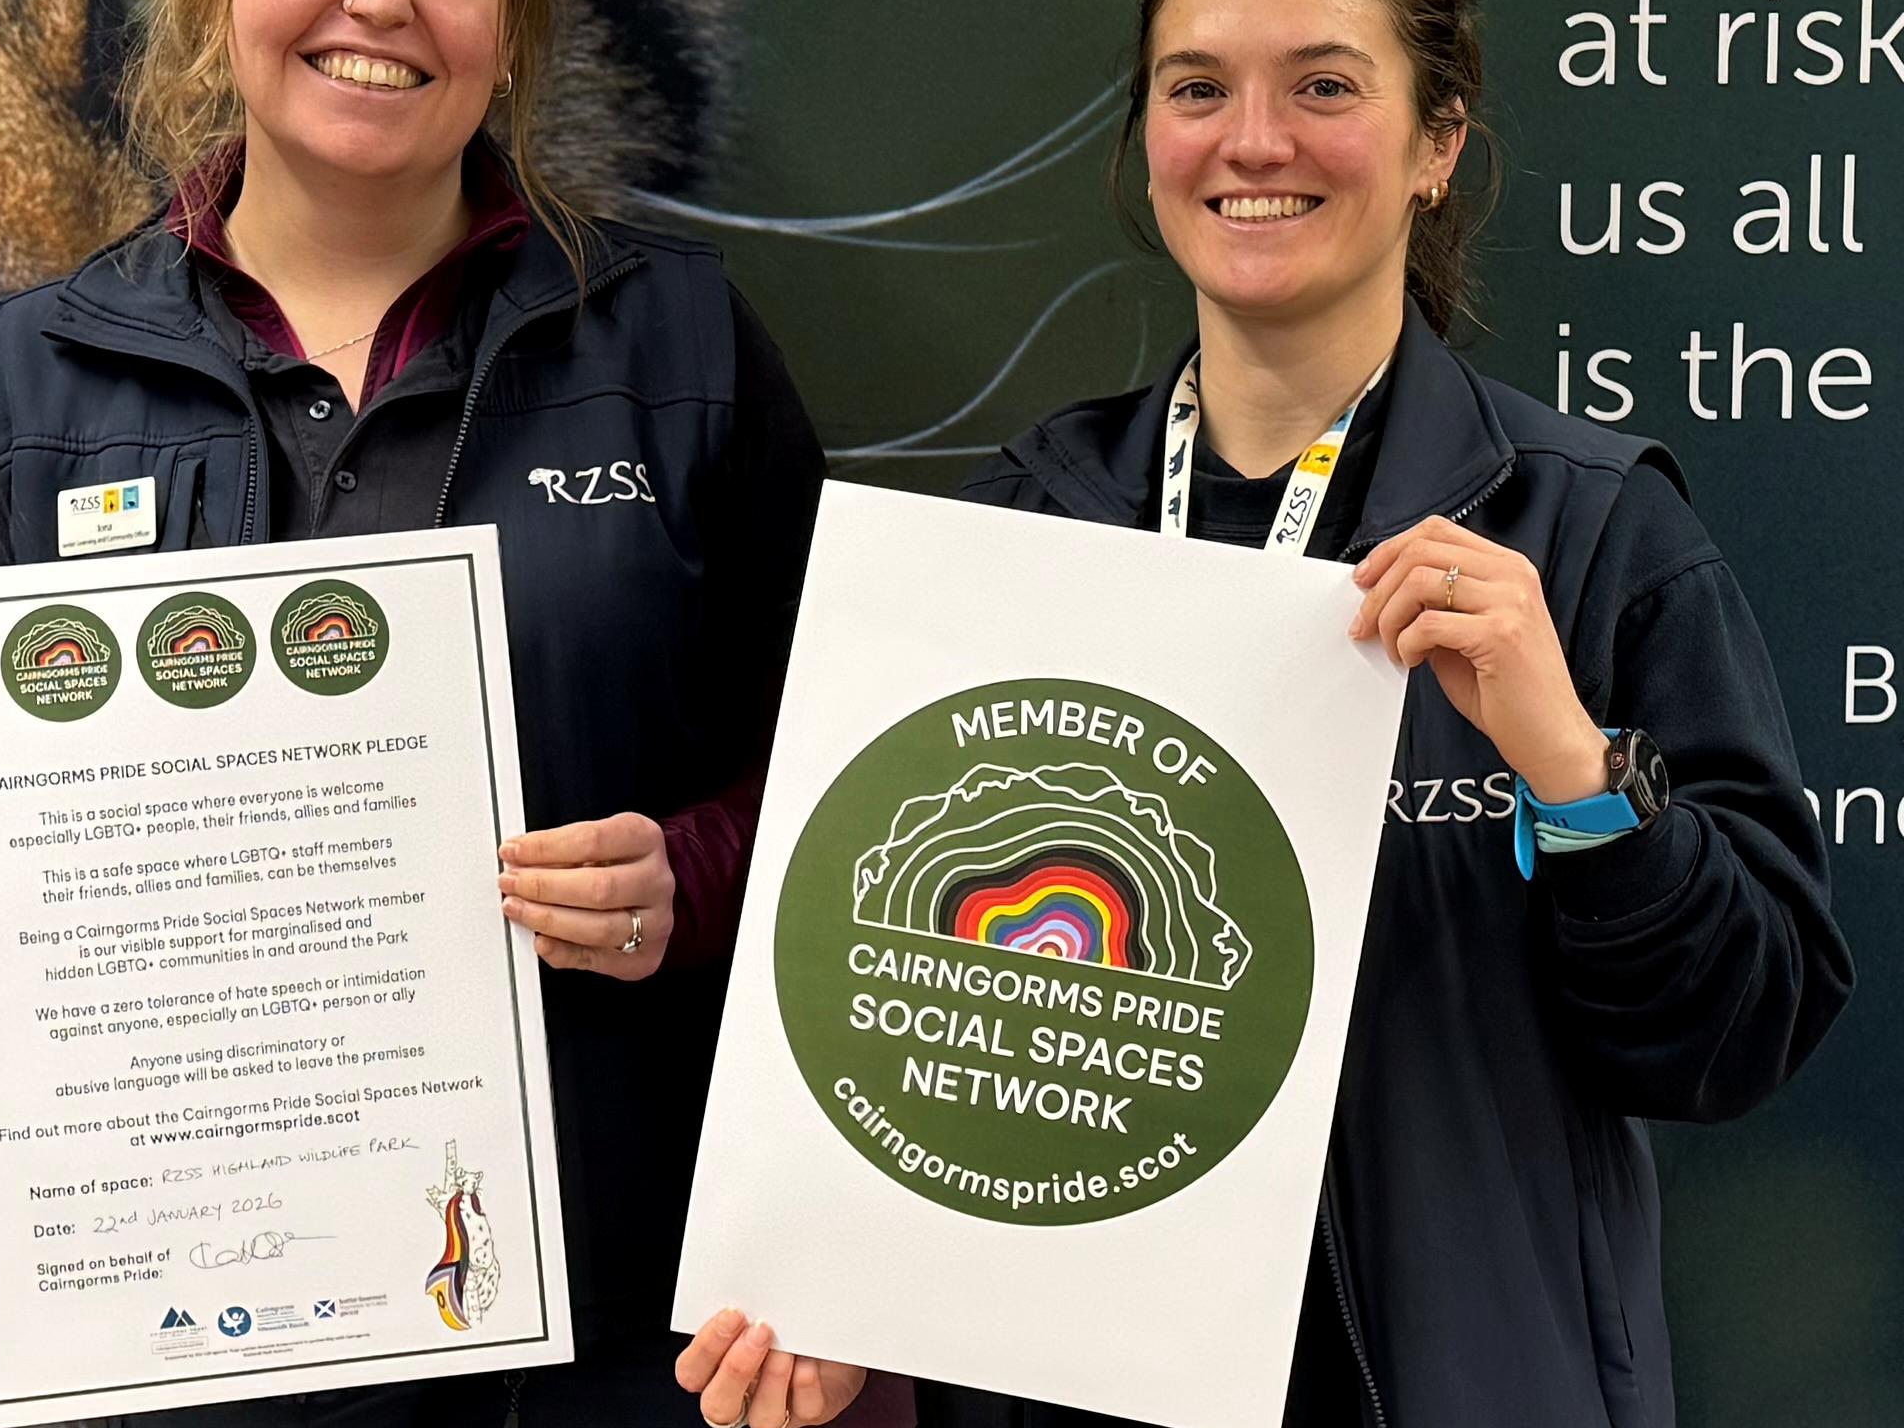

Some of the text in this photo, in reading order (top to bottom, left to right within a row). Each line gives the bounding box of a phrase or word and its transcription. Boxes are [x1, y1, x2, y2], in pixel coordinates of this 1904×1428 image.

[1561, 182, 1685, 254] us
[1733, 155, 1862, 253] all
[1559, 324, 1633, 421] is
[1681, 323, 1871, 419] the
[528, 461, 655, 504] RZSS
[1276, 486, 1313, 544] RZSS
[289, 650, 376, 668] SOCIAL SPACES
[306, 664, 362, 680] NETWORK
[99, 762, 147, 781] PRIDE
[150, 756, 212, 776] SOCIAL
[215, 749, 278, 770] SPACES
[281, 740, 363, 763] NETWORK
[366, 734, 429, 755] PLEDGE
[951, 699, 1218, 786] MEMBER OF
[37, 781, 385, 826] This is a social space where everyone is welcome
[848, 943, 1224, 1040] CAIRNGORMS PRIDE
[129, 1035, 346, 1072] Anyone using discriminatory or
[849, 993, 1204, 1091] SOCIAL SPACES
[35, 1124, 60, 1139] out
[63, 1121, 103, 1136] more
[106, 1113, 151, 1131] about
[154, 1110, 179, 1125] the
[182, 1101, 270, 1122] Cairngorms
[272, 1095, 312, 1112] Pride
[314, 1088, 361, 1107] Social
[363, 1085, 419, 1104] Spaces
[421, 1075, 484, 1095] Network
[902, 1056, 1132, 1134] NETWORK
[129, 1109, 361, 1147] at www.cairngormspride.scot
[834, 1077, 1197, 1210] cairngormspride.scot
[161, 1136, 420, 1184] RZSS HIGHLAND WILDLIFE PARK
[29, 1176, 153, 1201] Name of space:
[146, 1203, 222, 1227] JANUARY
[231, 1192, 283, 1214] 2026
[33, 1223, 76, 1239] Date:
[36, 1258, 85, 1277] Signed
[88, 1259, 106, 1270] on
[108, 1250, 153, 1268] behalf
[156, 1247, 171, 1263] of
[38, 1267, 163, 1293] Cairngorms Pride:
